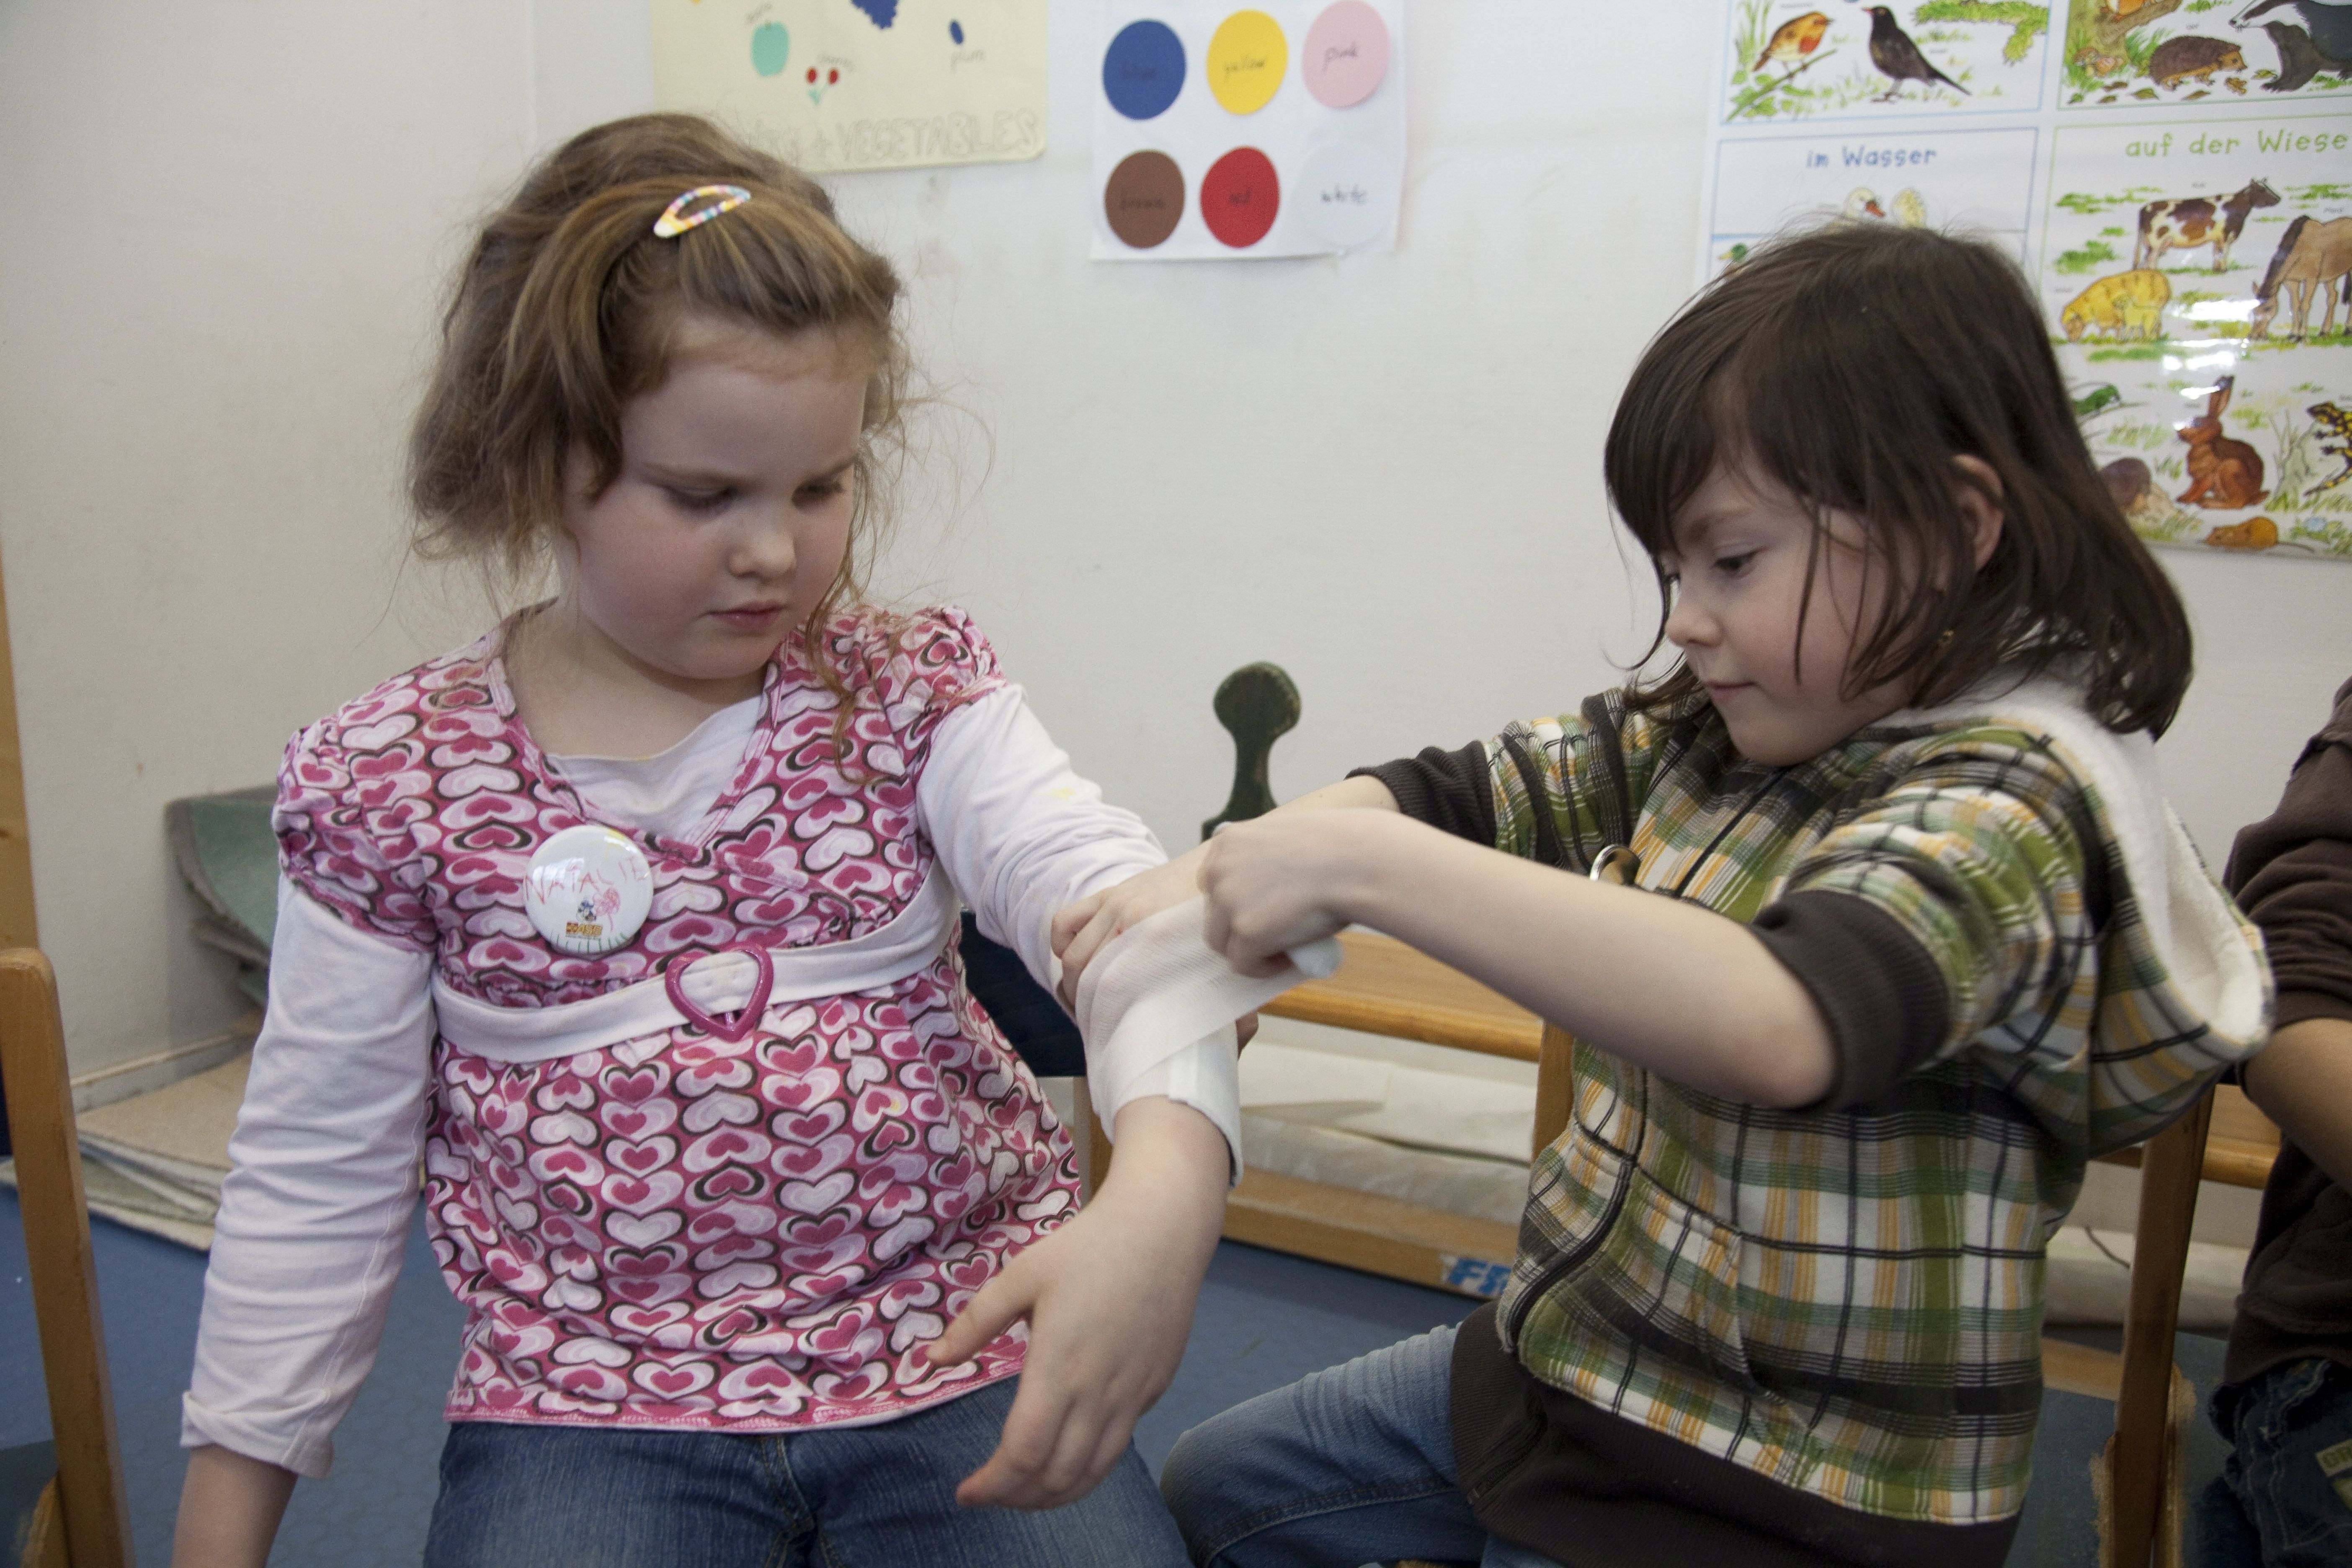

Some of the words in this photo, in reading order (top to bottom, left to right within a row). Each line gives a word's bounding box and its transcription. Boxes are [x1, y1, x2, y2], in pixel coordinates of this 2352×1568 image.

[836, 107, 1039, 163] VEGETABLES
[2125, 133, 2173, 157] auf
[2190, 133, 2241, 155] der
[2257, 128, 2349, 153] Wiese
[1806, 150, 1829, 168] im
[1844, 145, 1937, 168] Wasser
